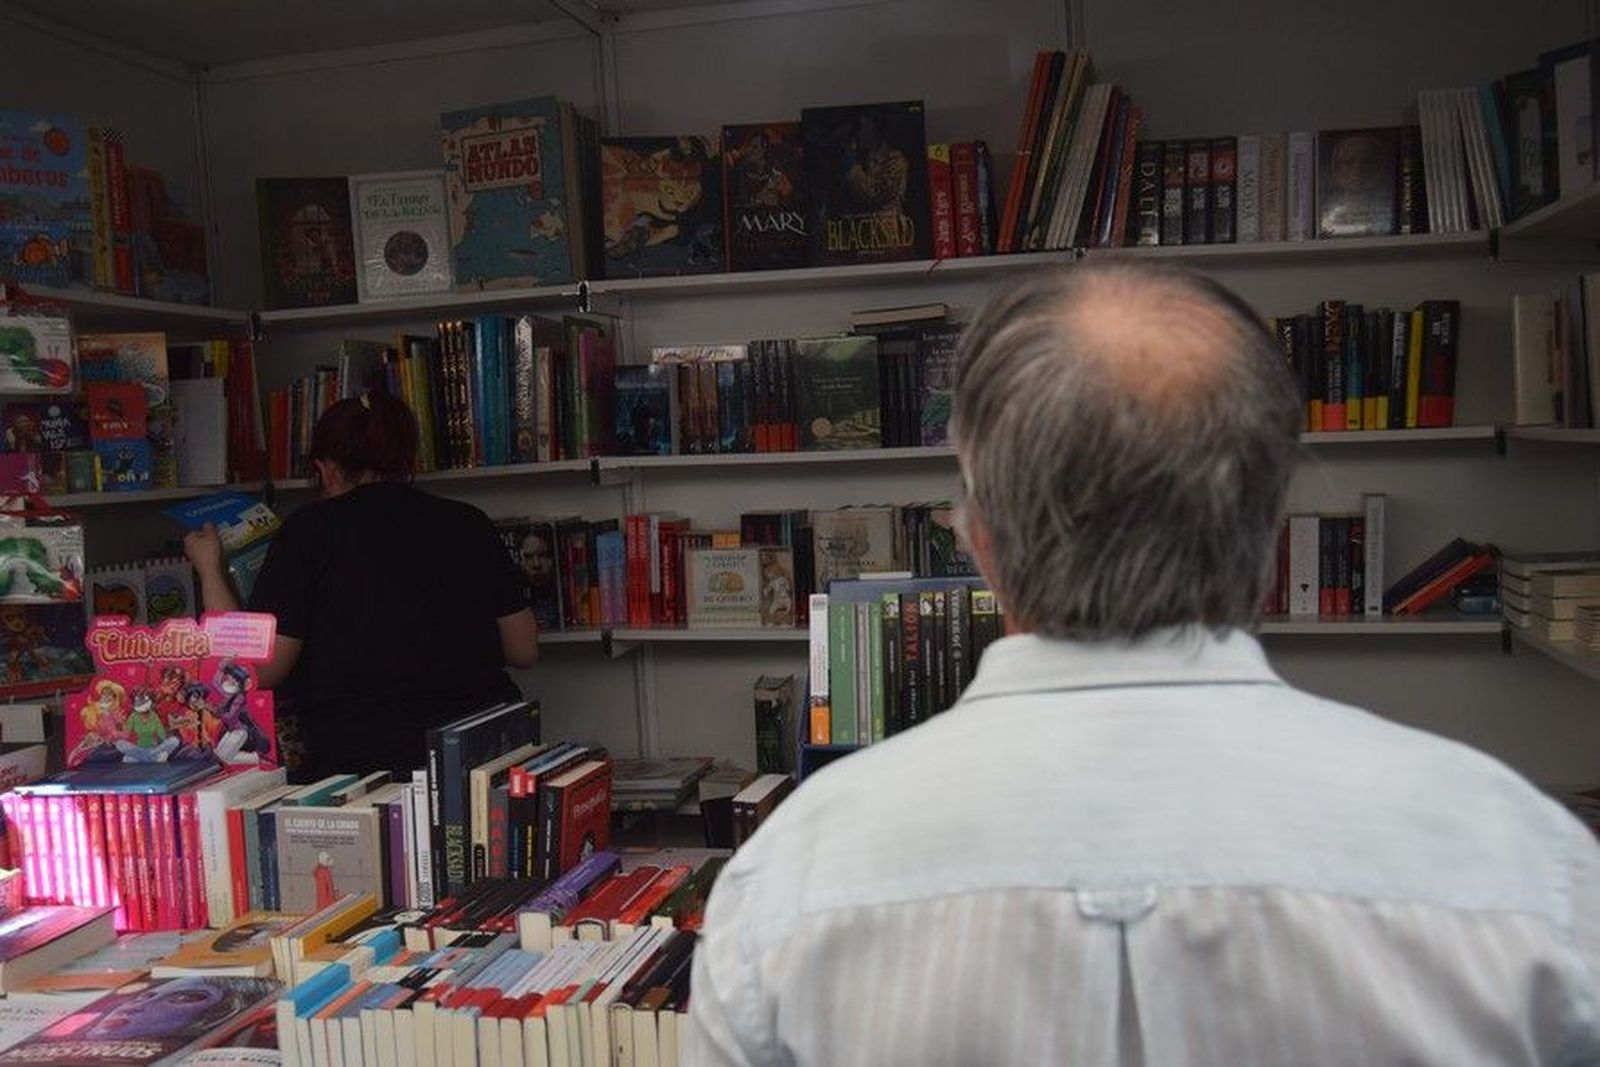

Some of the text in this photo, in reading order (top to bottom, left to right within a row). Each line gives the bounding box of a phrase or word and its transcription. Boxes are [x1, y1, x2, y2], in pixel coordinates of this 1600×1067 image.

[467, 135, 536, 162] ATLAS
[467, 156, 539, 183] MUNDO
[737, 210, 812, 240] MARY
[826, 213, 917, 252] BLACKSAD
[93, 630, 150, 662] Club
[168, 627, 210, 657] Tea
